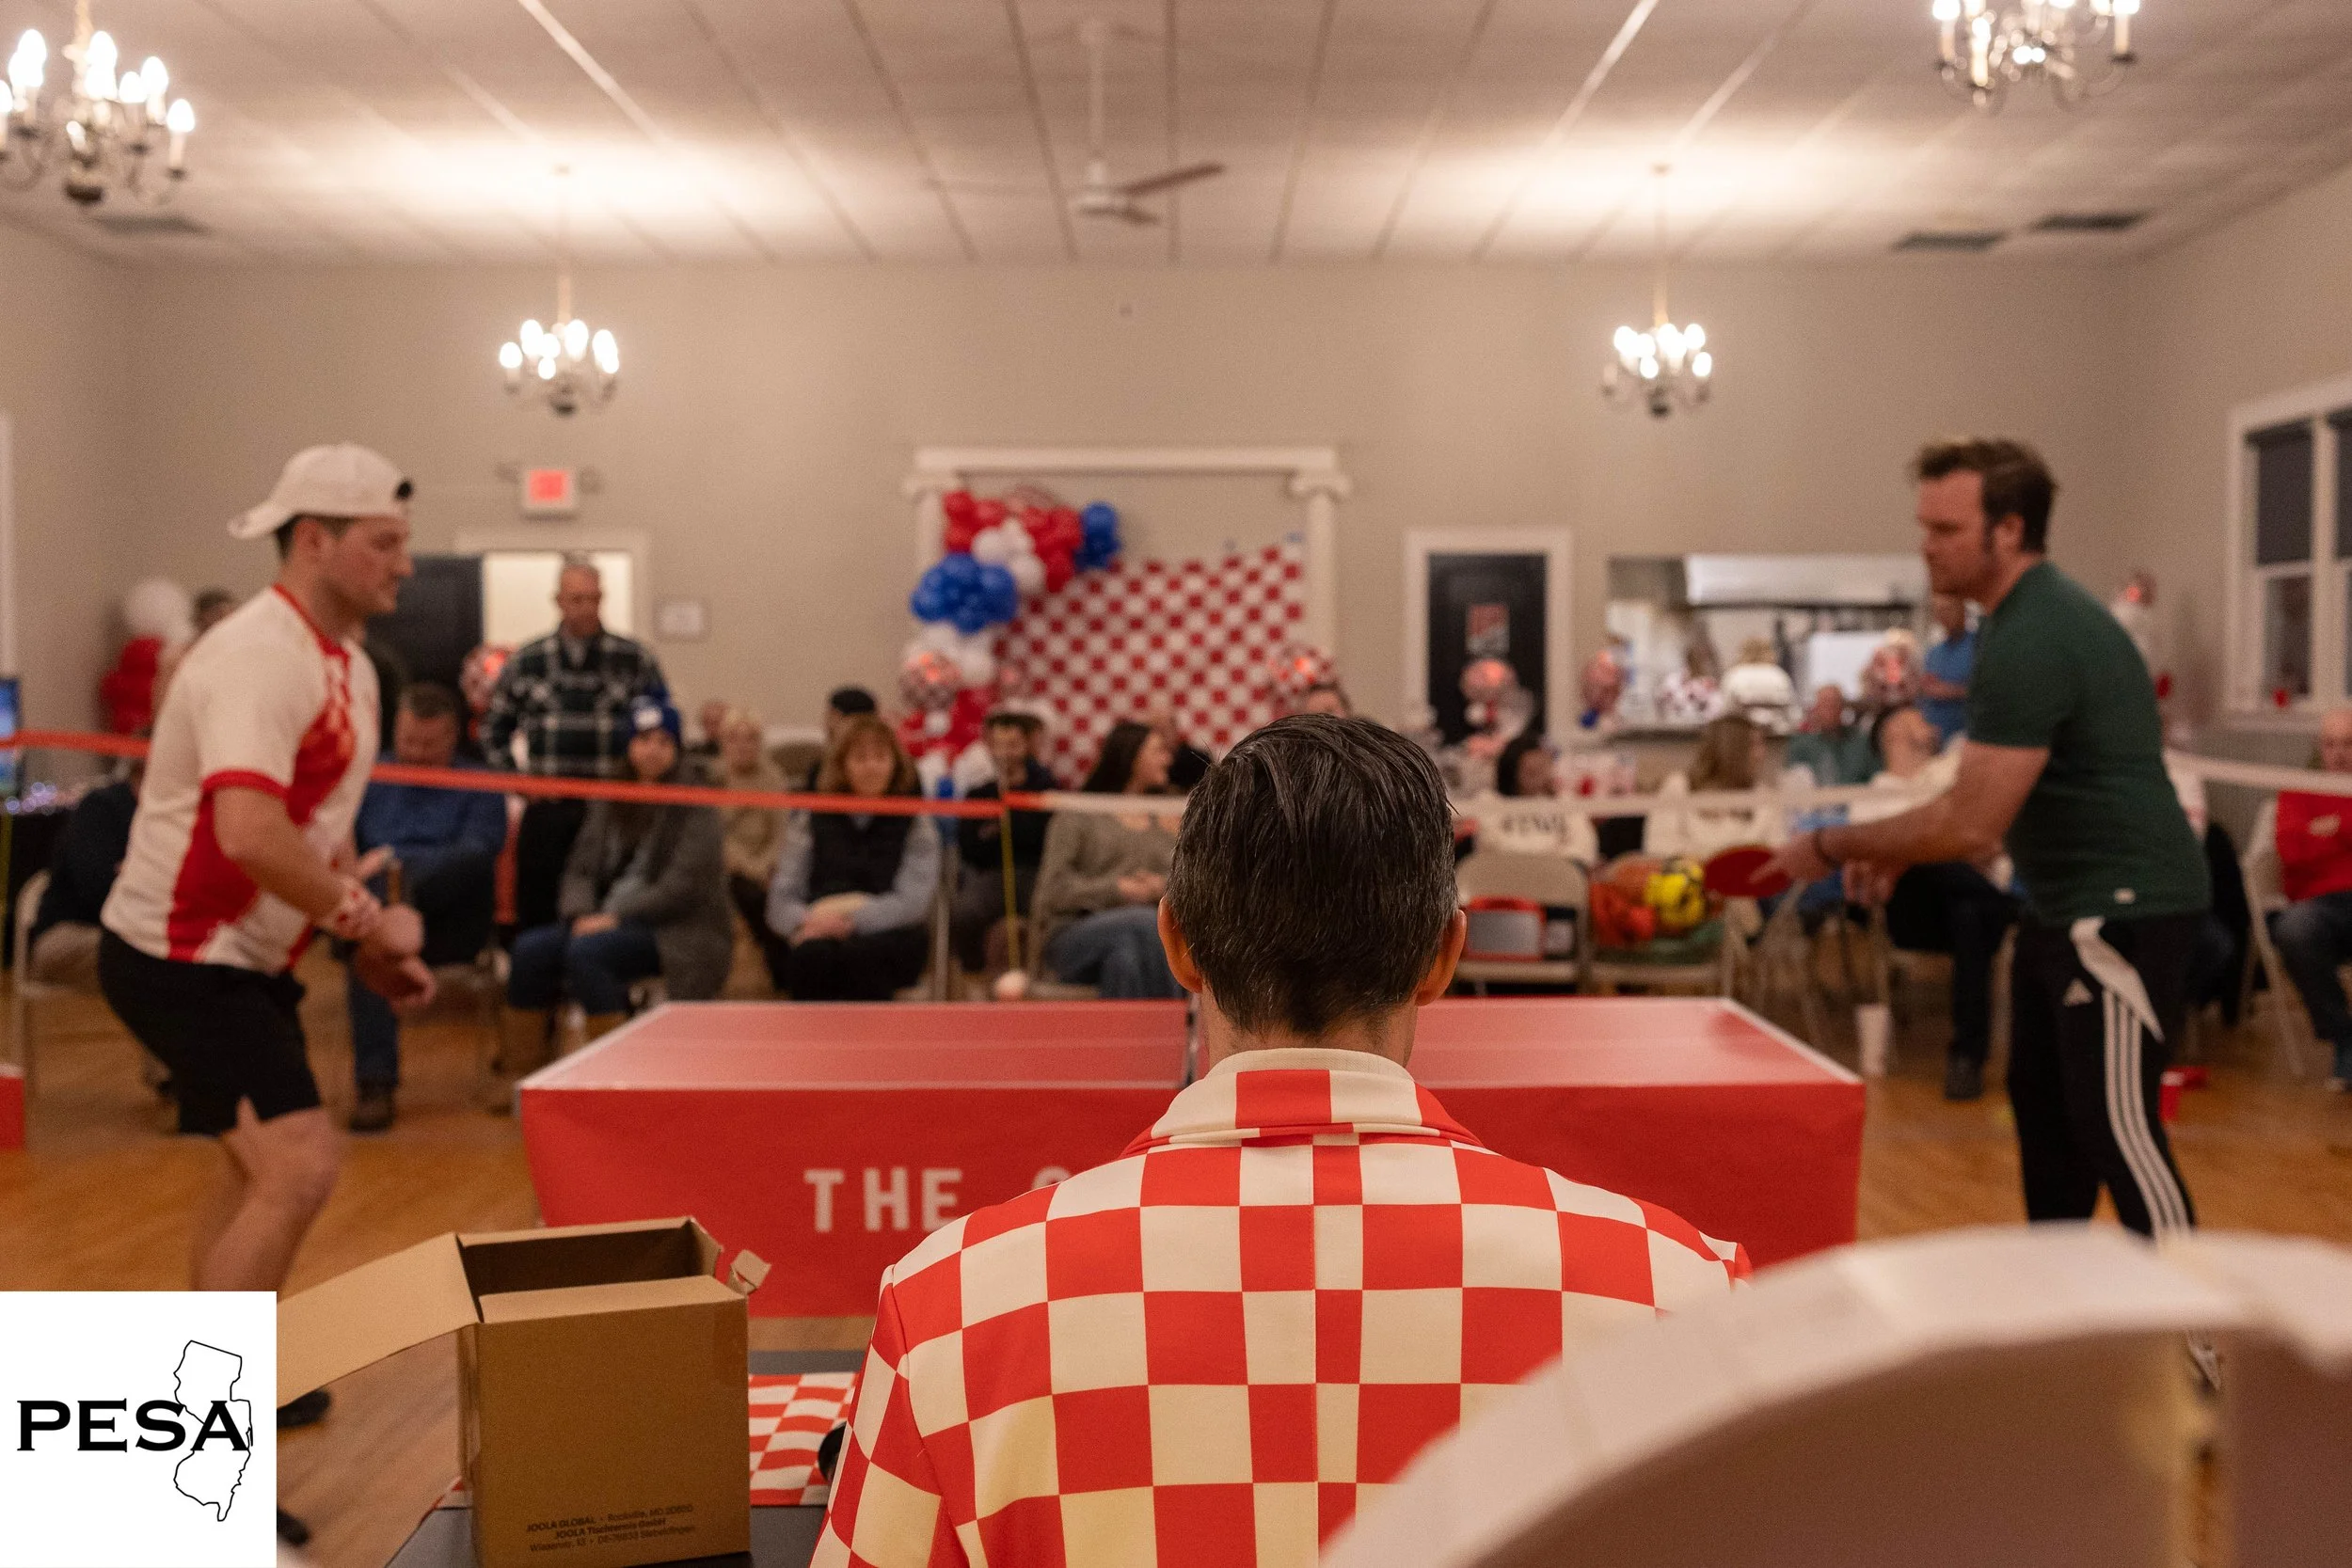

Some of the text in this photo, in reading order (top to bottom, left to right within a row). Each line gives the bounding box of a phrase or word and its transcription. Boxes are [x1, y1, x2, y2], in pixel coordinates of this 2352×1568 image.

[803, 1167, 963, 1232] THE
[526, 1521, 557, 1533] JOOLA
[559, 1516, 596, 1528] GLOBAL
[555, 1528, 585, 1540] JOOLA
